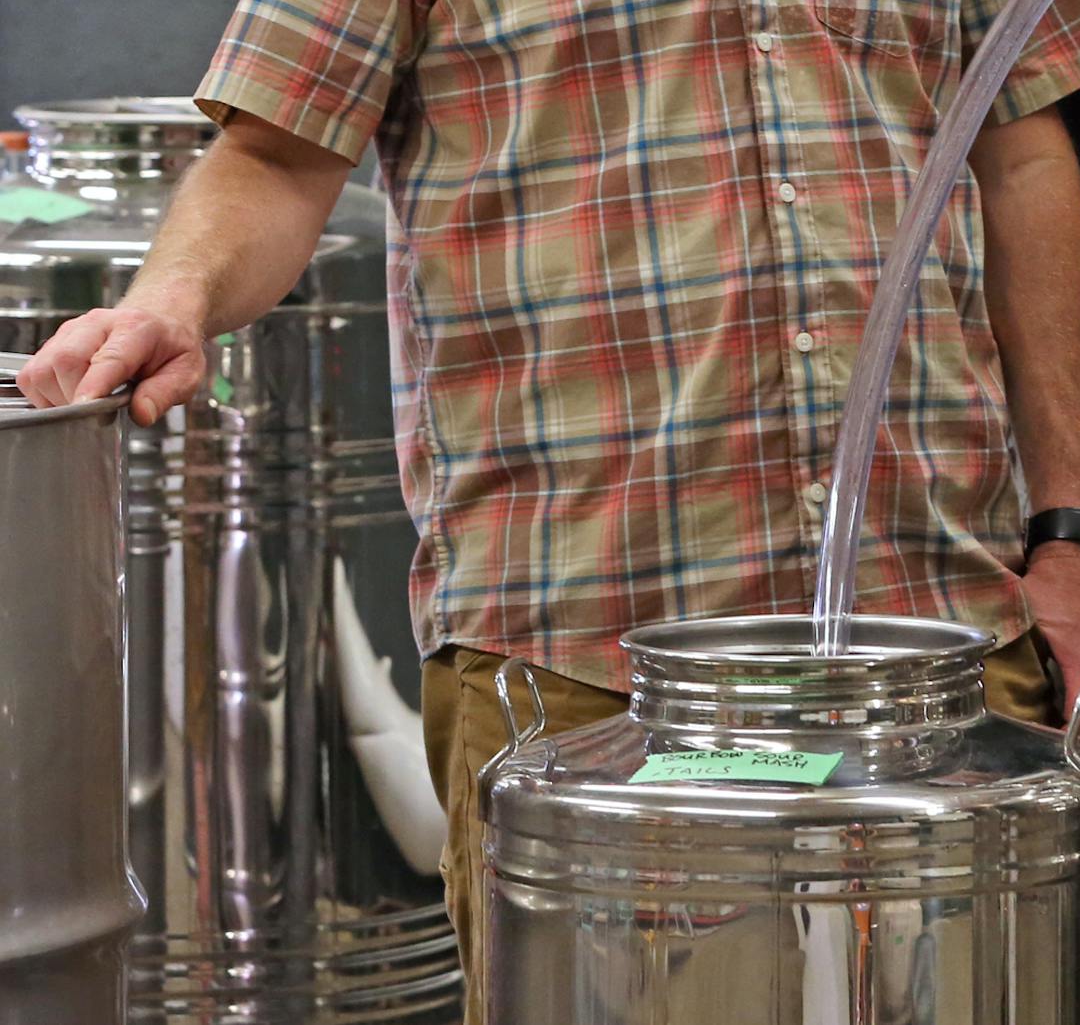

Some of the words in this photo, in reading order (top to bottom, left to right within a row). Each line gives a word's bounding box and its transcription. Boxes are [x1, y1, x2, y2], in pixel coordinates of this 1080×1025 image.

[661, 751, 744, 763] BOURBON
[753, 751, 805, 761] SOUR
[751, 758, 809, 769] MASH
